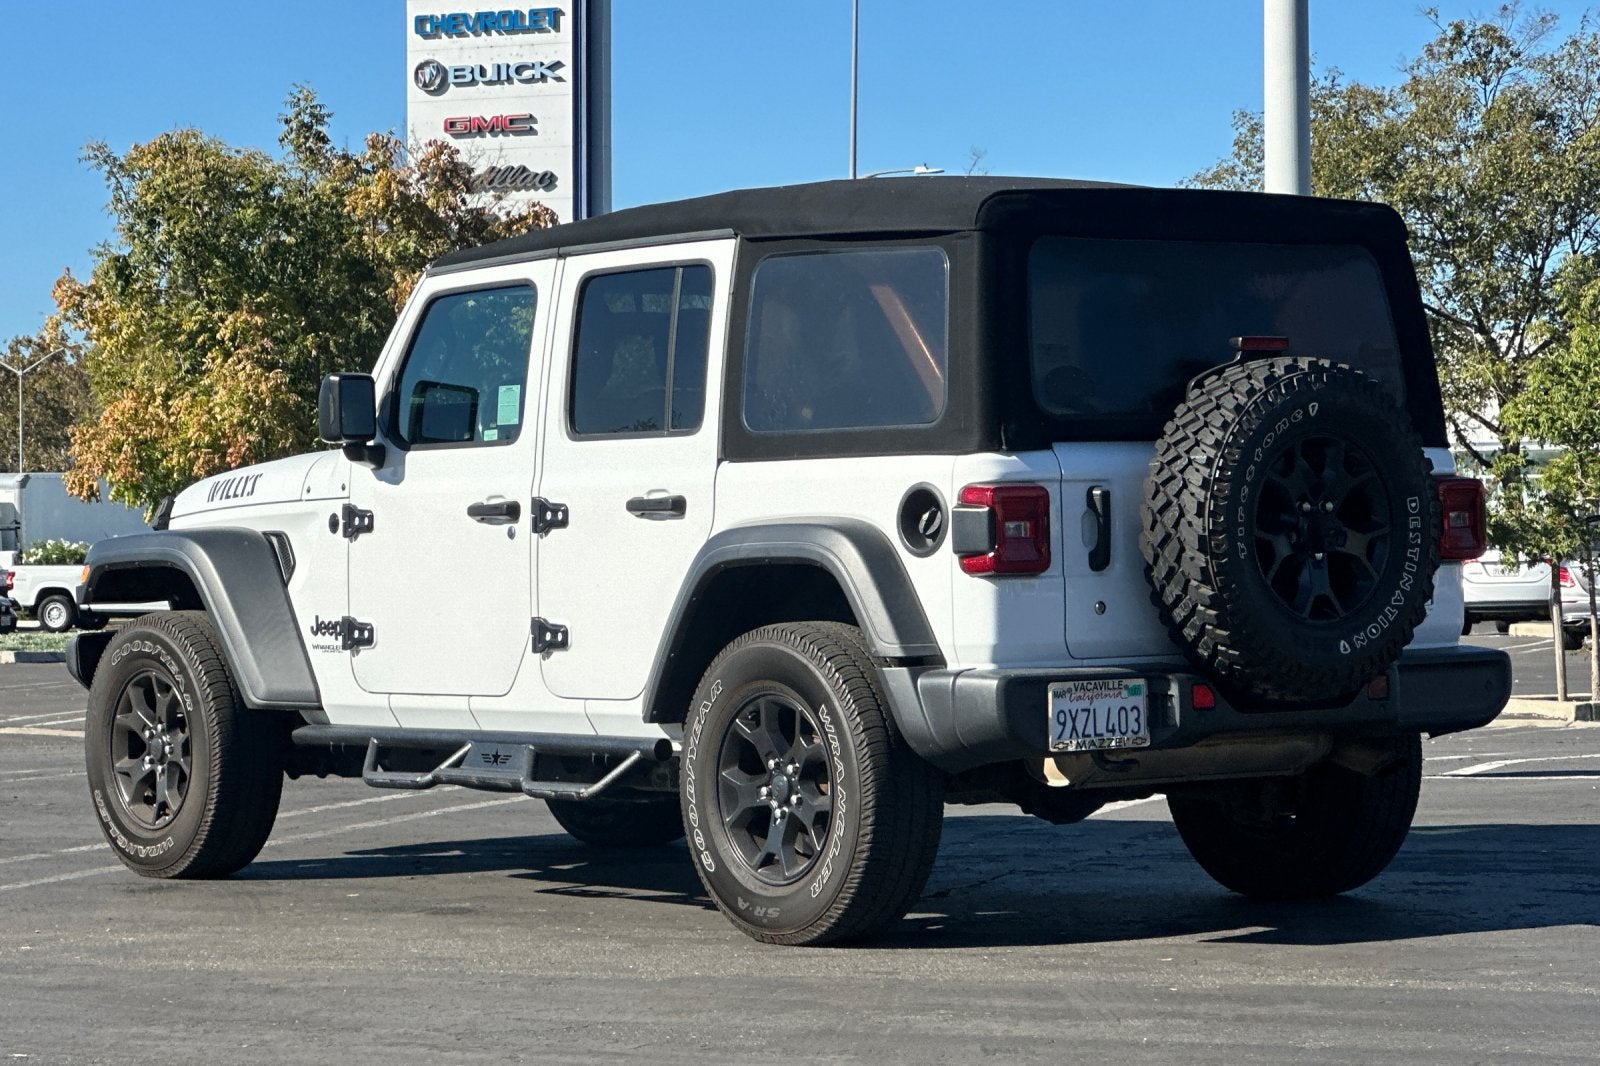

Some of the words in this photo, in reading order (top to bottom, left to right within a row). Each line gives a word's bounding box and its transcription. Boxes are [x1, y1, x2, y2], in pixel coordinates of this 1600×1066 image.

[414, 7, 564, 36] CHEVROLET
[449, 60, 566, 84] BUICK
[443, 113, 535, 136] GMC
[207, 473, 263, 502] WILLYS
[1354, 496, 1421, 650] DESTINATION
[310, 615, 343, 641] Jeep
[111, 640, 193, 711] GOODYEAR
[1073, 680, 1123, 692] VACAVILLE
[1053, 690, 1067, 699] MAR
[1069, 691, 1128, 705] California
[1056, 705, 1141, 740] 9XZL403
[685, 679, 722, 872] GOODYEAR
[810, 704, 846, 898] WRANGLER
[94, 789, 174, 857] WRANGLER
